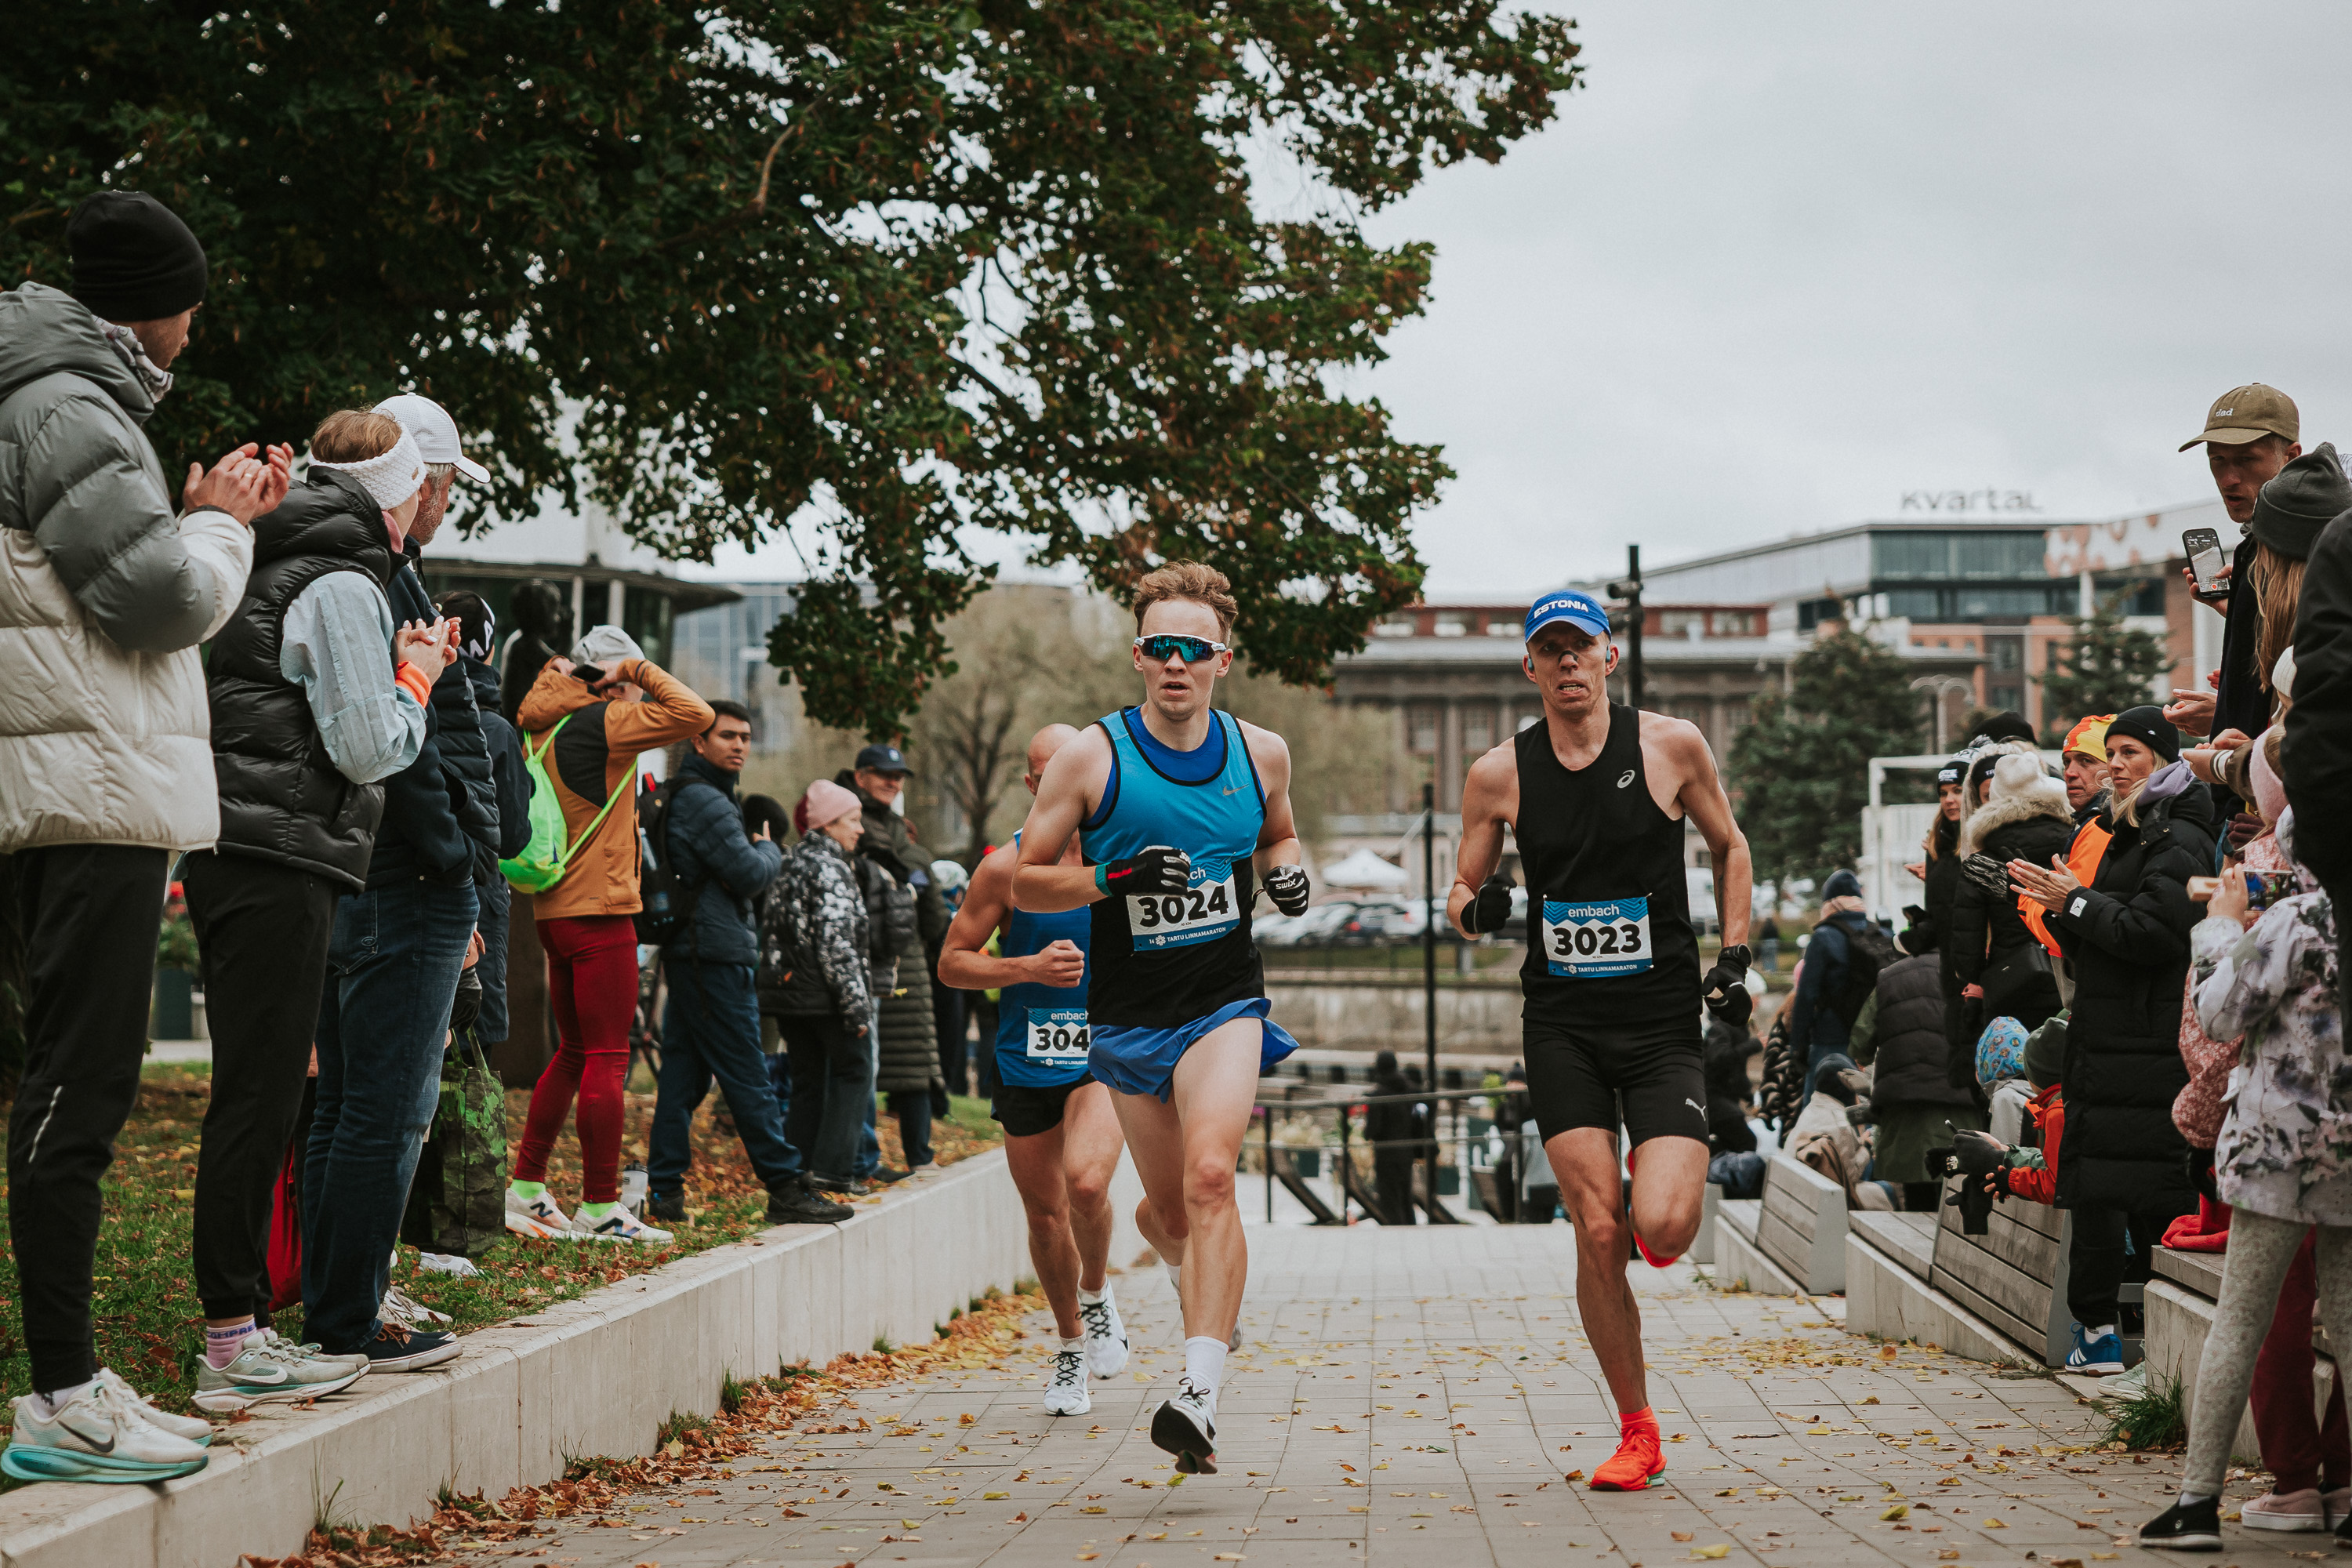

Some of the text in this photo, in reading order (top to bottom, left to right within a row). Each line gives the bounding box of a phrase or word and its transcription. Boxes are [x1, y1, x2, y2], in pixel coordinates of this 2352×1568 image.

[2216, 408, 2234, 417] dad
[1534, 600, 1589, 619] ESTONIA
[1137, 885, 1229, 927] 3024
[1568, 904, 1620, 917] embach
[1185, 927, 1226, 939] LINNAMARATON
[1552, 924, 1642, 956] 3023
[1034, 1028, 1090, 1051] 304
